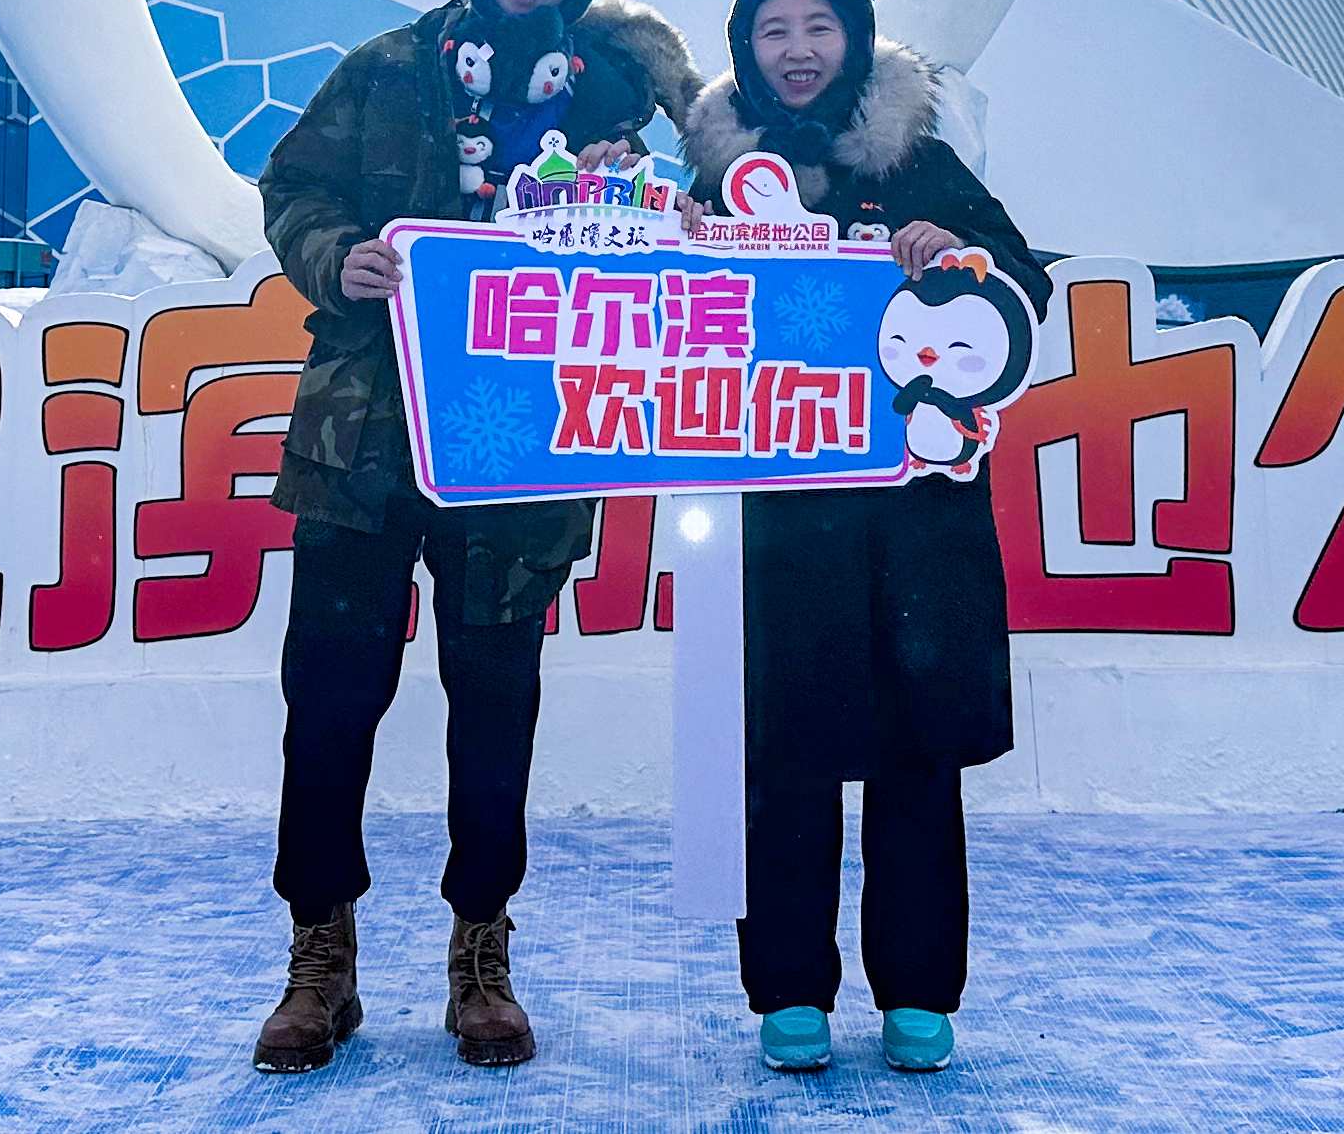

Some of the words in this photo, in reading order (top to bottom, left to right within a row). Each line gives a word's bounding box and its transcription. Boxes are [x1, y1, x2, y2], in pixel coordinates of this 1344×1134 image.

[687, 221, 831, 242] 哈尔滨极地公园
[737, 242, 771, 251] HARBIN
[471, 271, 750, 358] 哈尔滨
[556, 363, 868, 454] 欢迎你!
